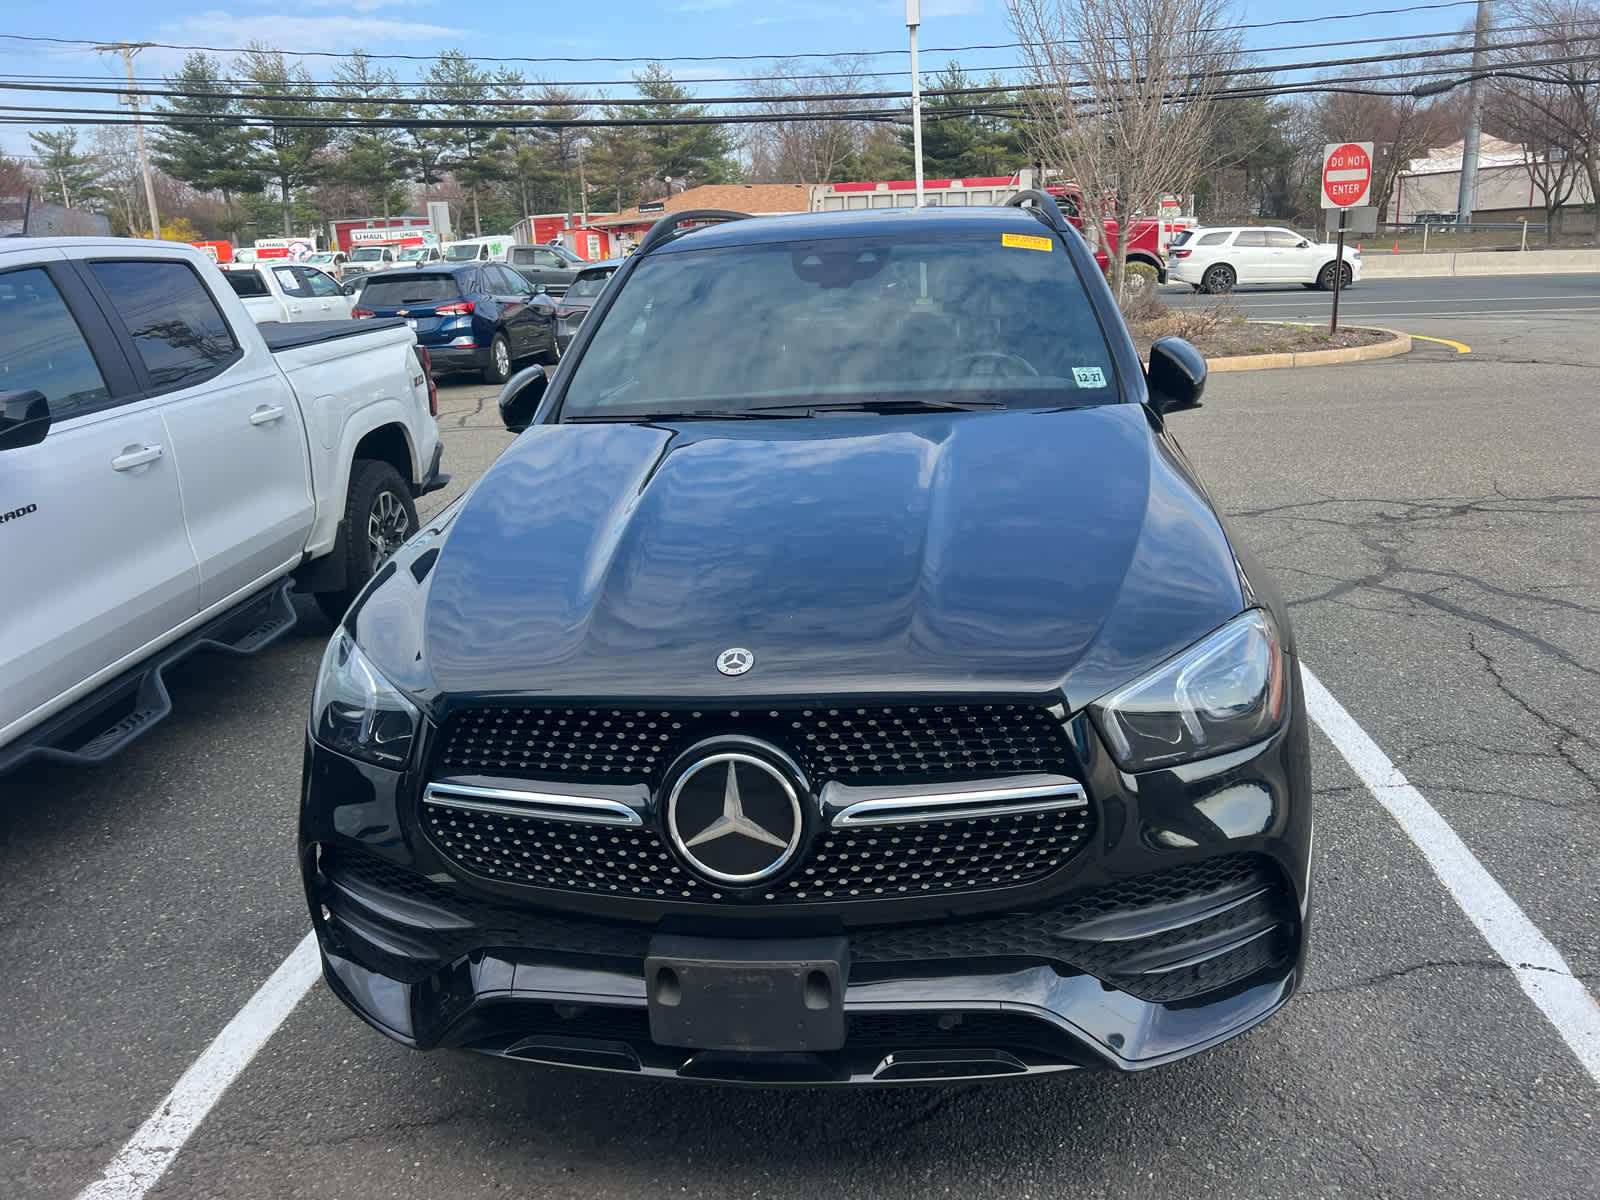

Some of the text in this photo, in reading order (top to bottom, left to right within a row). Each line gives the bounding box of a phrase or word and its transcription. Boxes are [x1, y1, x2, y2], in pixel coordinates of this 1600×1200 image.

[1331, 155, 1365, 167] DO NOT
[1332, 184, 1360, 195] ENTER
